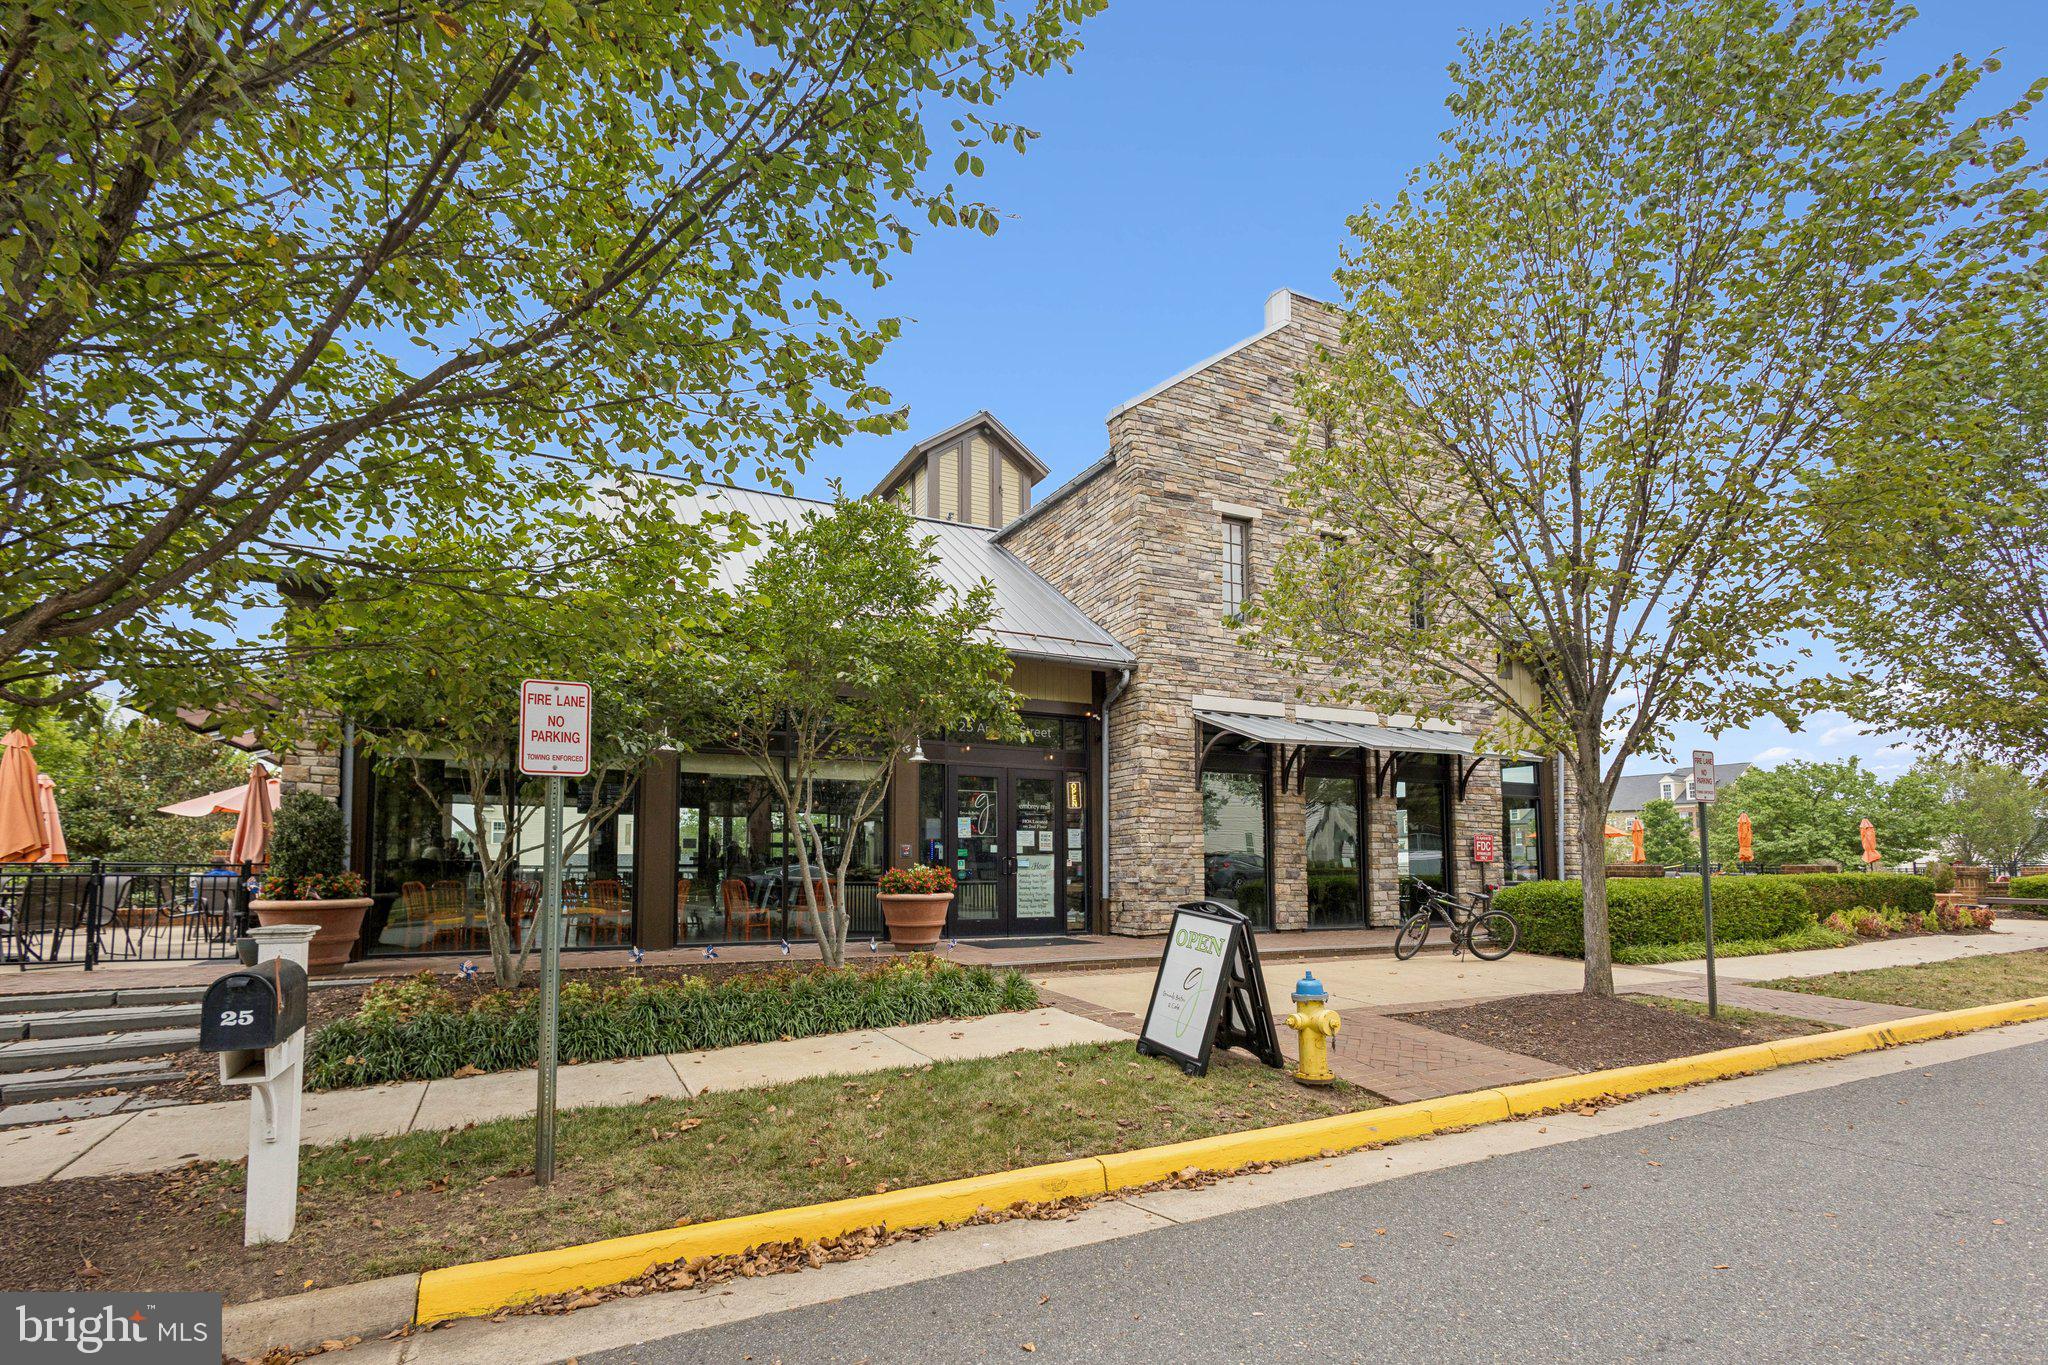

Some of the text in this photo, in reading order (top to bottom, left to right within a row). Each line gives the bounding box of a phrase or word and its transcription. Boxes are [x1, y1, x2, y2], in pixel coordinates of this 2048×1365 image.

[527, 693, 586, 708] FIRE LANE
[547, 715, 565, 728] NO
[531, 730, 581, 744] PARKING
[527, 753, 584, 762] TOWING ENFORCED
[1697, 777, 1712, 785] PARKING
[1070, 783, 1078, 808] OPEN
[1476, 841, 1491, 851] FDC
[1175, 929, 1225, 957] OPEN
[220, 1009, 255, 1027] 25
